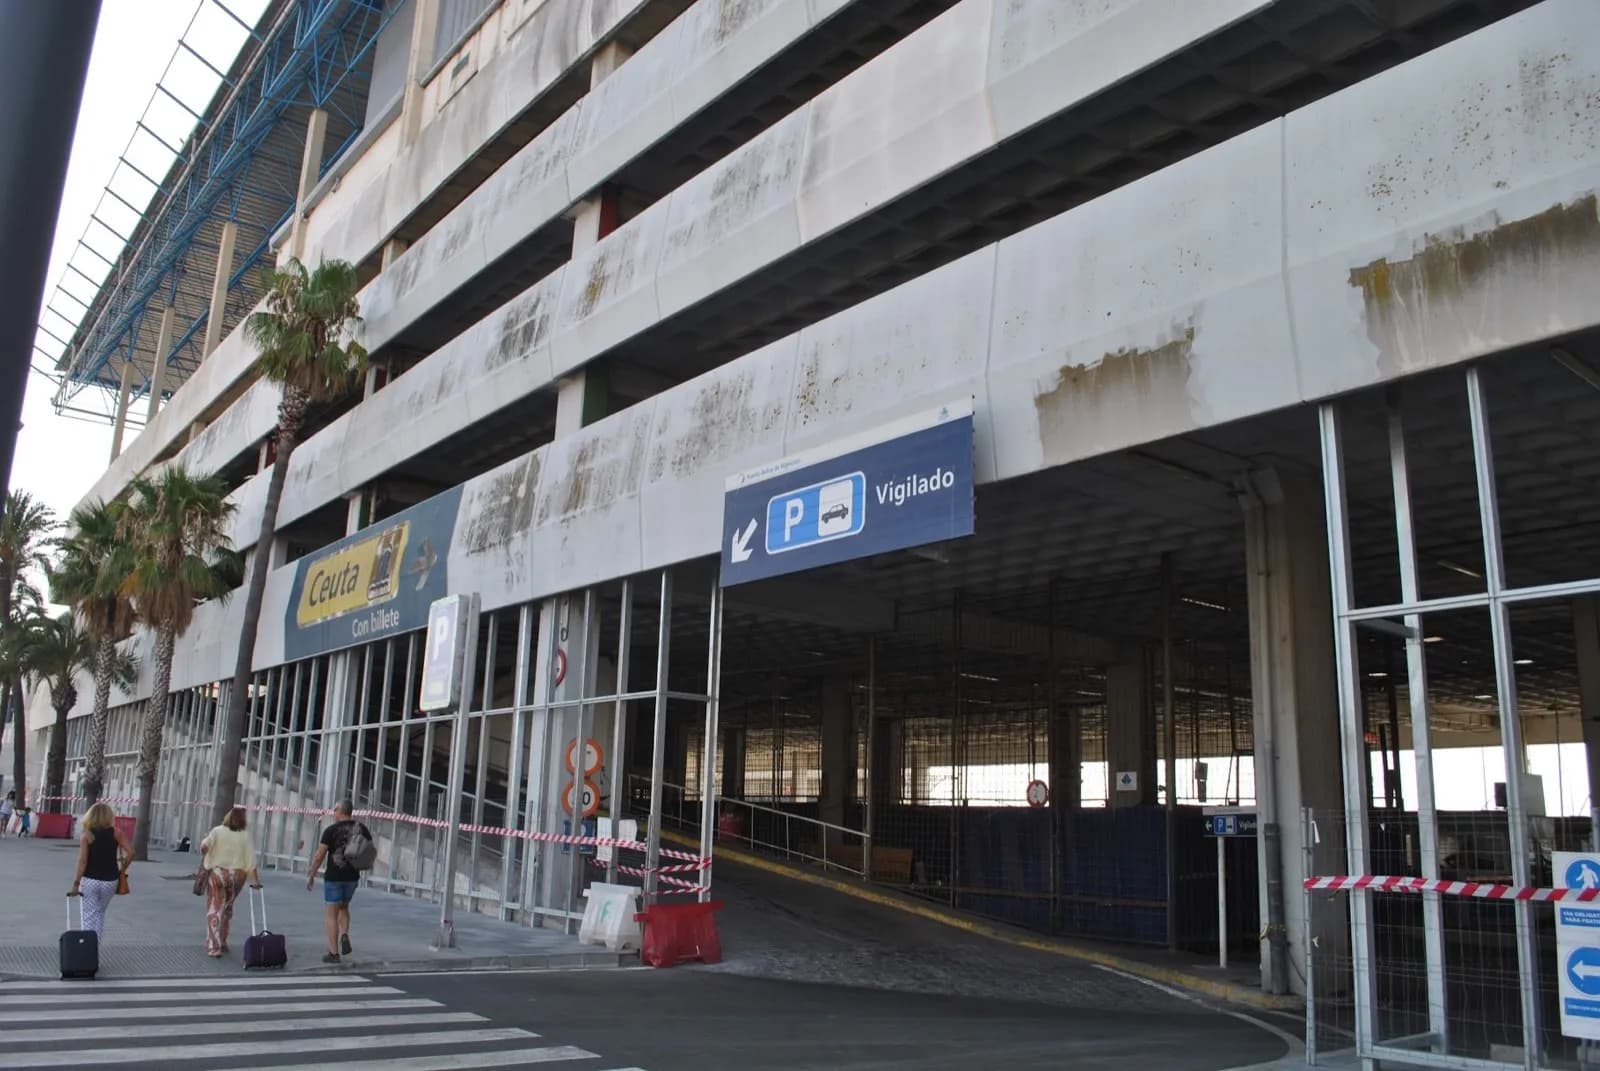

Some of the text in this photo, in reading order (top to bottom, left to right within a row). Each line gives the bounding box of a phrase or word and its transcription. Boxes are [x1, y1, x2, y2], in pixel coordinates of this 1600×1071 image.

[784, 467, 955, 542] P Vigilado
[308, 561, 360, 608] Ceuta
[352, 608, 400, 638] Con billete
[433, 616, 449, 662] P
[1218, 818, 1258, 833] P Vigilad
